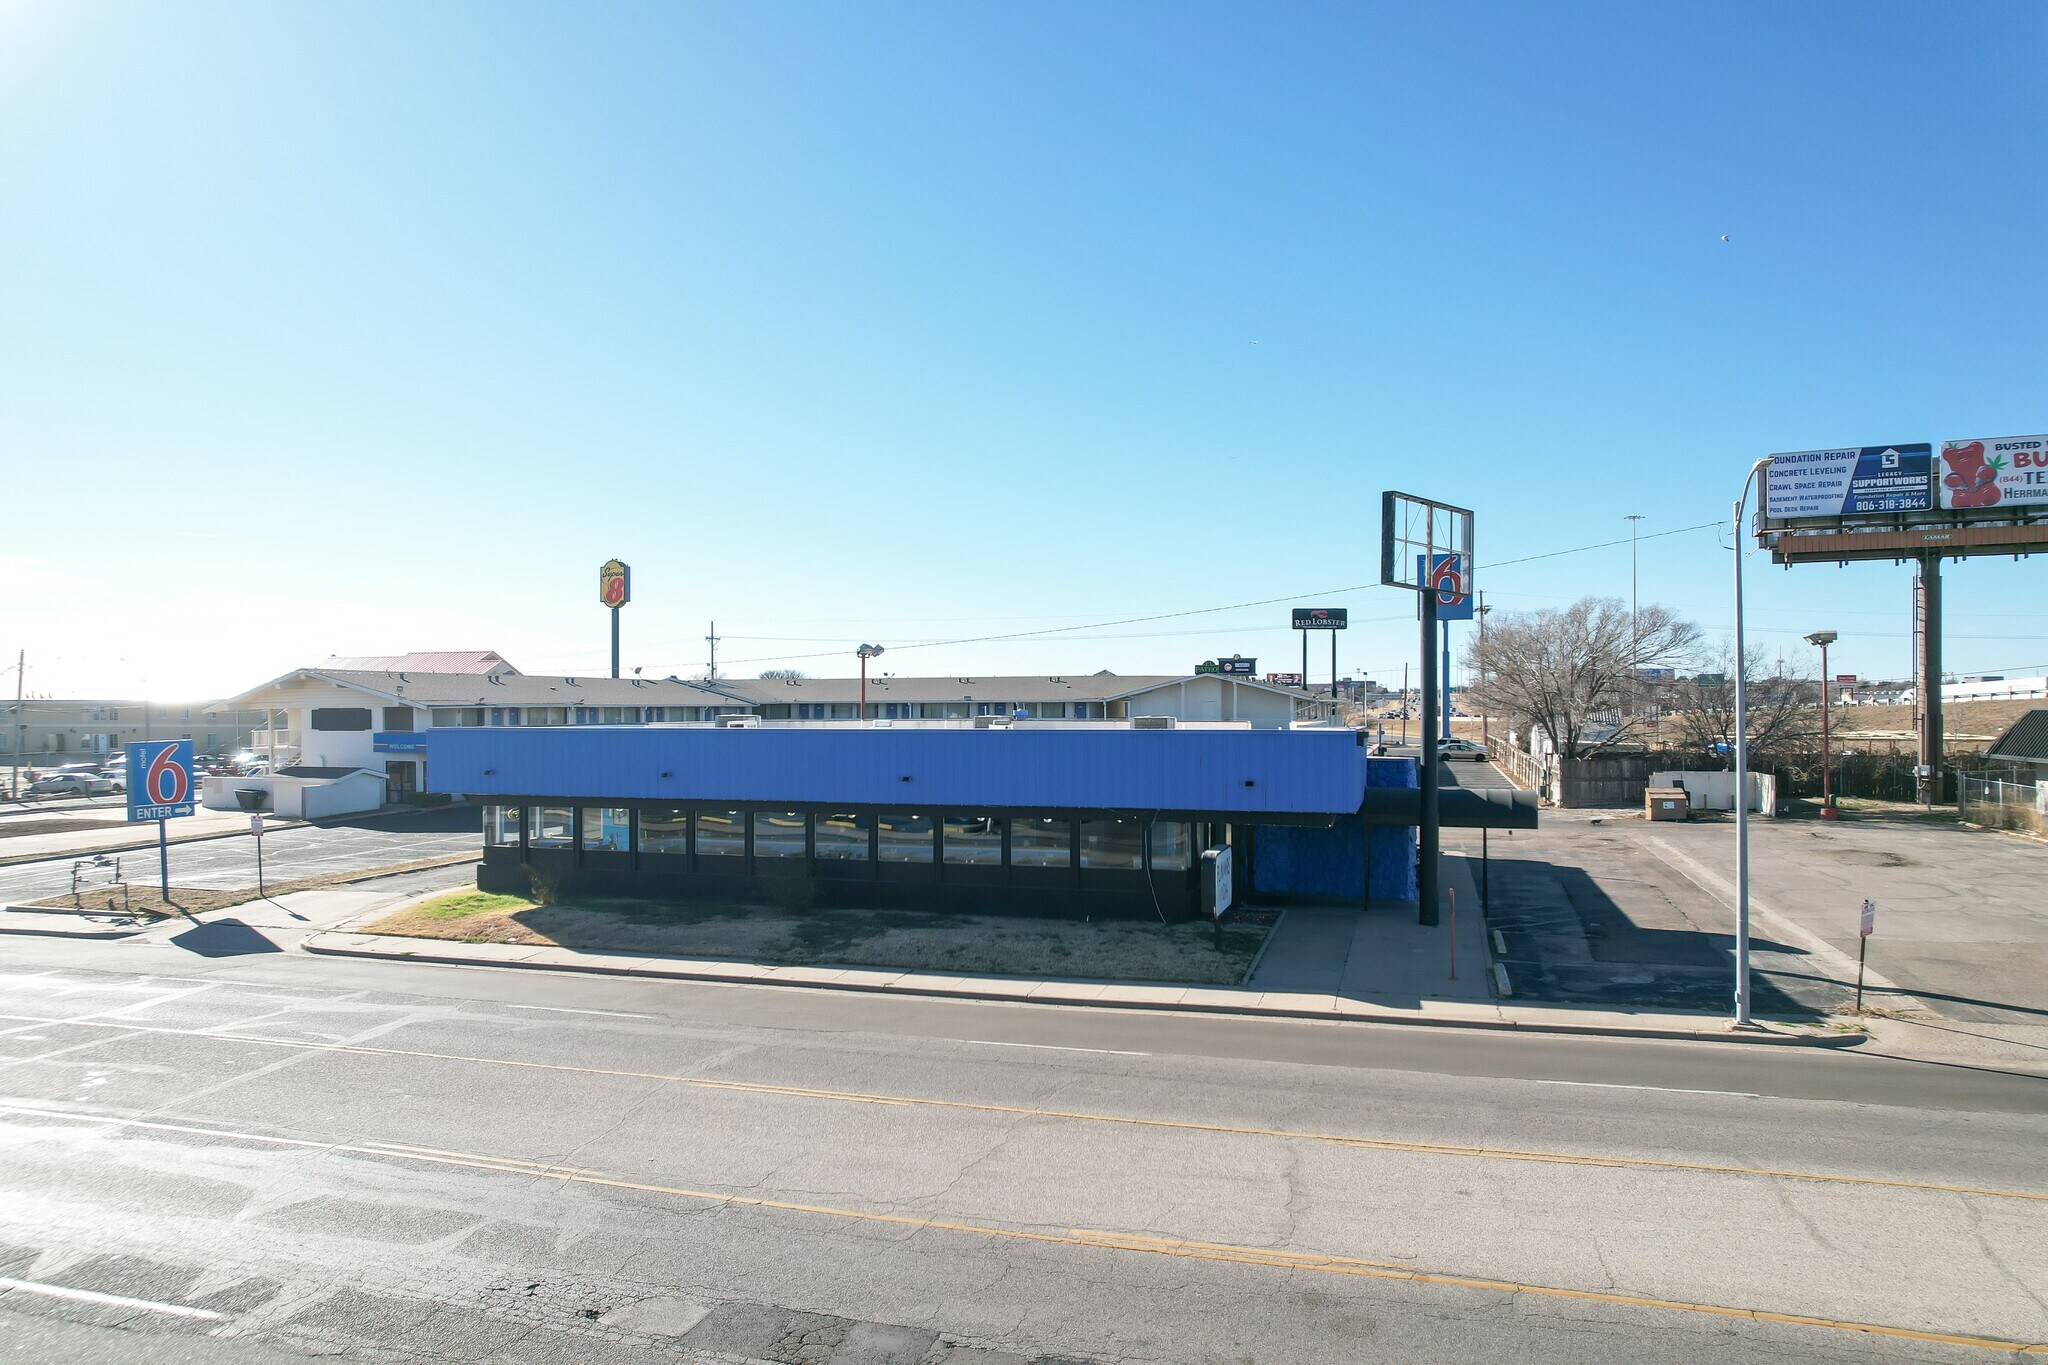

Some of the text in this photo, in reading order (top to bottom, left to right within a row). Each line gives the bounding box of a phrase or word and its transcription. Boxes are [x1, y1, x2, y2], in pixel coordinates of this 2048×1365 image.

[1995, 441, 2041, 451] BUSTED
[1769, 451, 1856, 465] OUNDATION REPAIR
[1769, 466, 1847, 478] CONCRETE LEVELING
[1999, 471, 2048, 485] (844) TE
[1794, 482, 1816, 490] SPACE
[1852, 476, 1928, 487] SUPPORTWORKS
[1799, 493, 1844, 501] WATERPROOFING
[1856, 498, 1927, 511] 806-318-3844
[605, 577, 624, 604] 8
[1295, 619, 1311, 627] RED
[1312, 618, 1346, 627] LOBSTER
[146, 743, 188, 804] 6
[136, 806, 172, 819] ENTER
